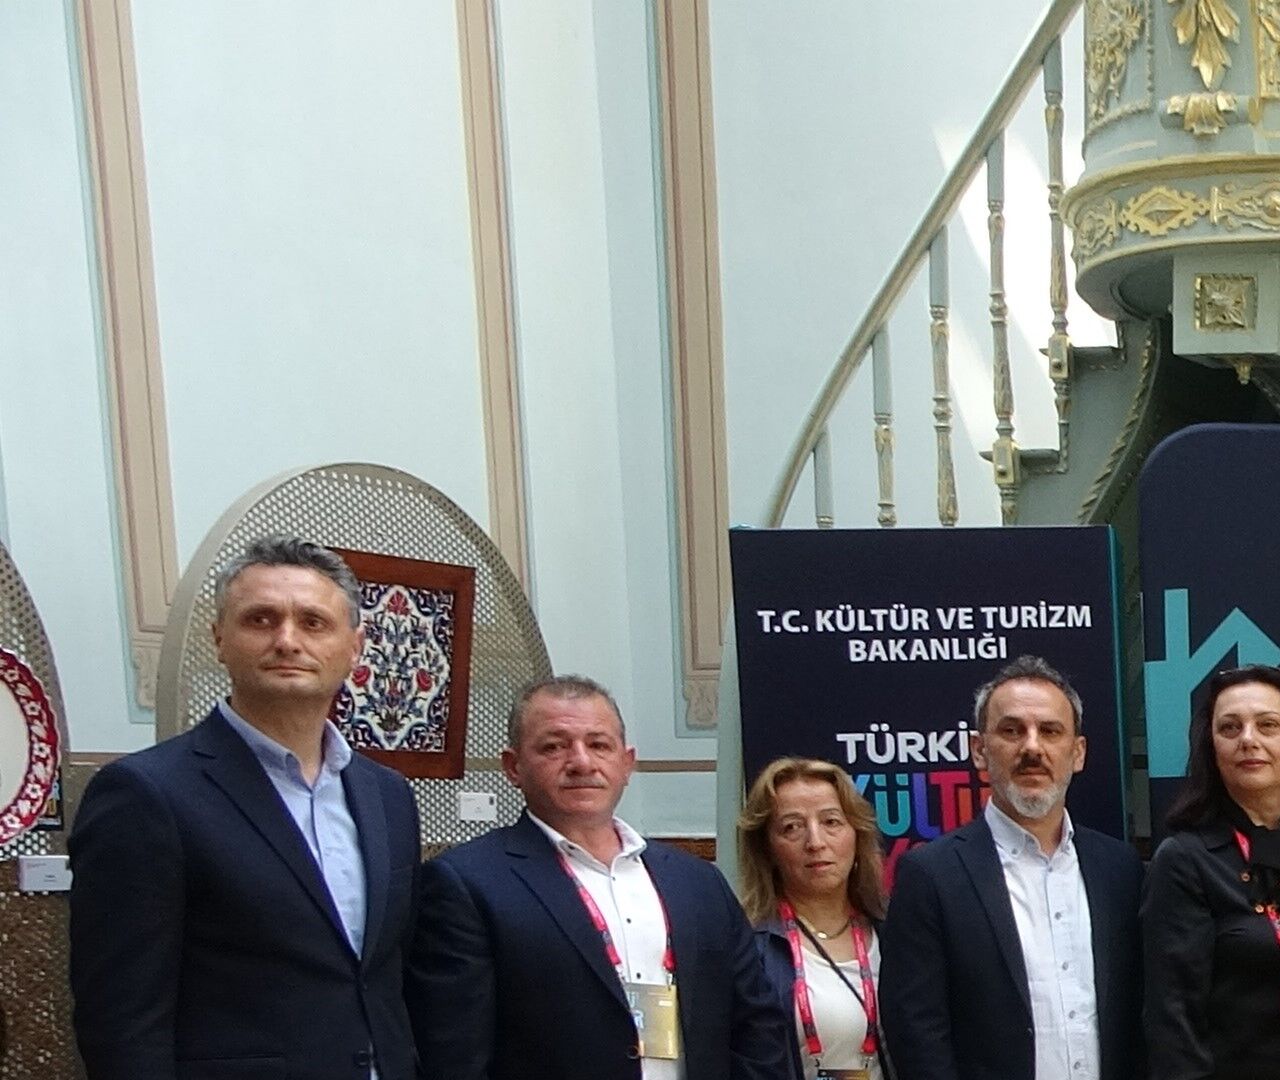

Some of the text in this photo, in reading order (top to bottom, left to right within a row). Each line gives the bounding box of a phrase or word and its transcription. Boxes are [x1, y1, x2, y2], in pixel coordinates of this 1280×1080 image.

[757, 600, 1092, 633] T.C. KÜLTÜR VE TURİZM
[848, 633, 1007, 662] BAKANLIĞI
[836, 721, 979, 764] TÜRKİ
